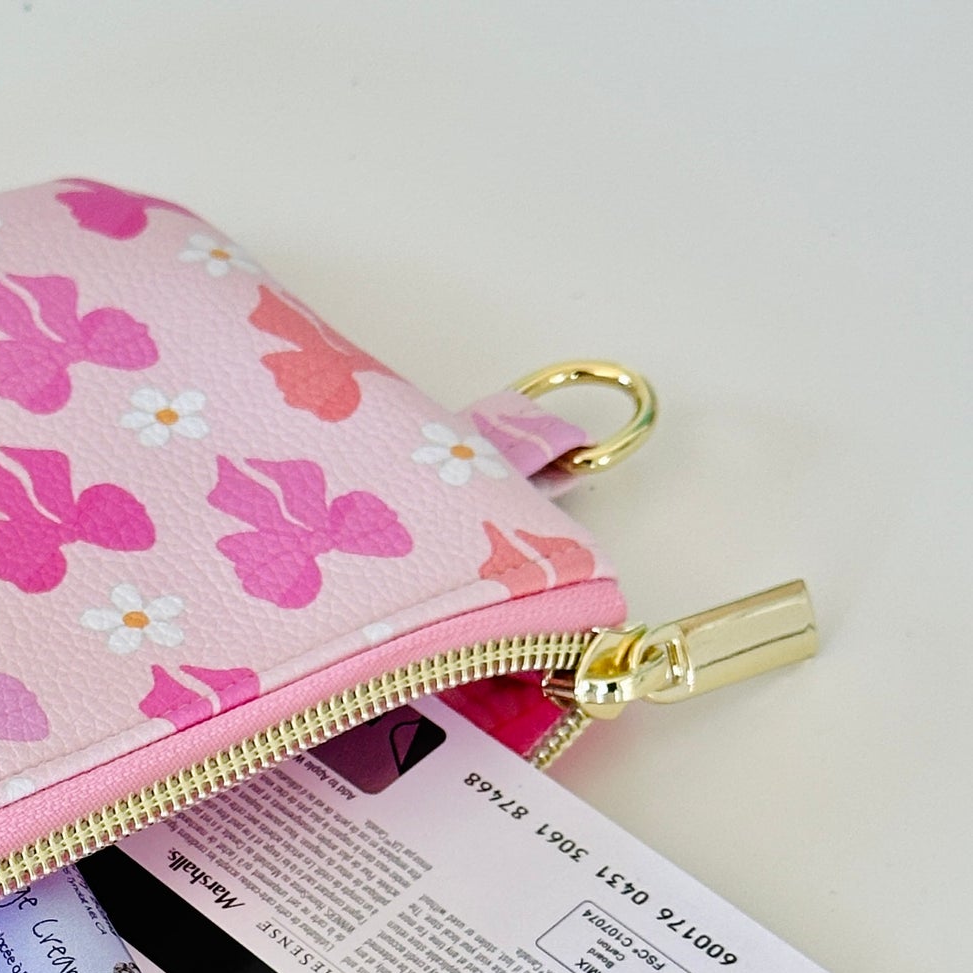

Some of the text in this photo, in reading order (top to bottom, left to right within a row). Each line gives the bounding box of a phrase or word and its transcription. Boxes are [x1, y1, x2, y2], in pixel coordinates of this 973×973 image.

[166, 849, 246, 910] Marshalls
[463, 771, 738, 966] 600176 0431 3061 87468
[581, 908, 634, 948] C107074
[585, 946, 615, 970] Board
[595, 937, 626, 962] Carton
